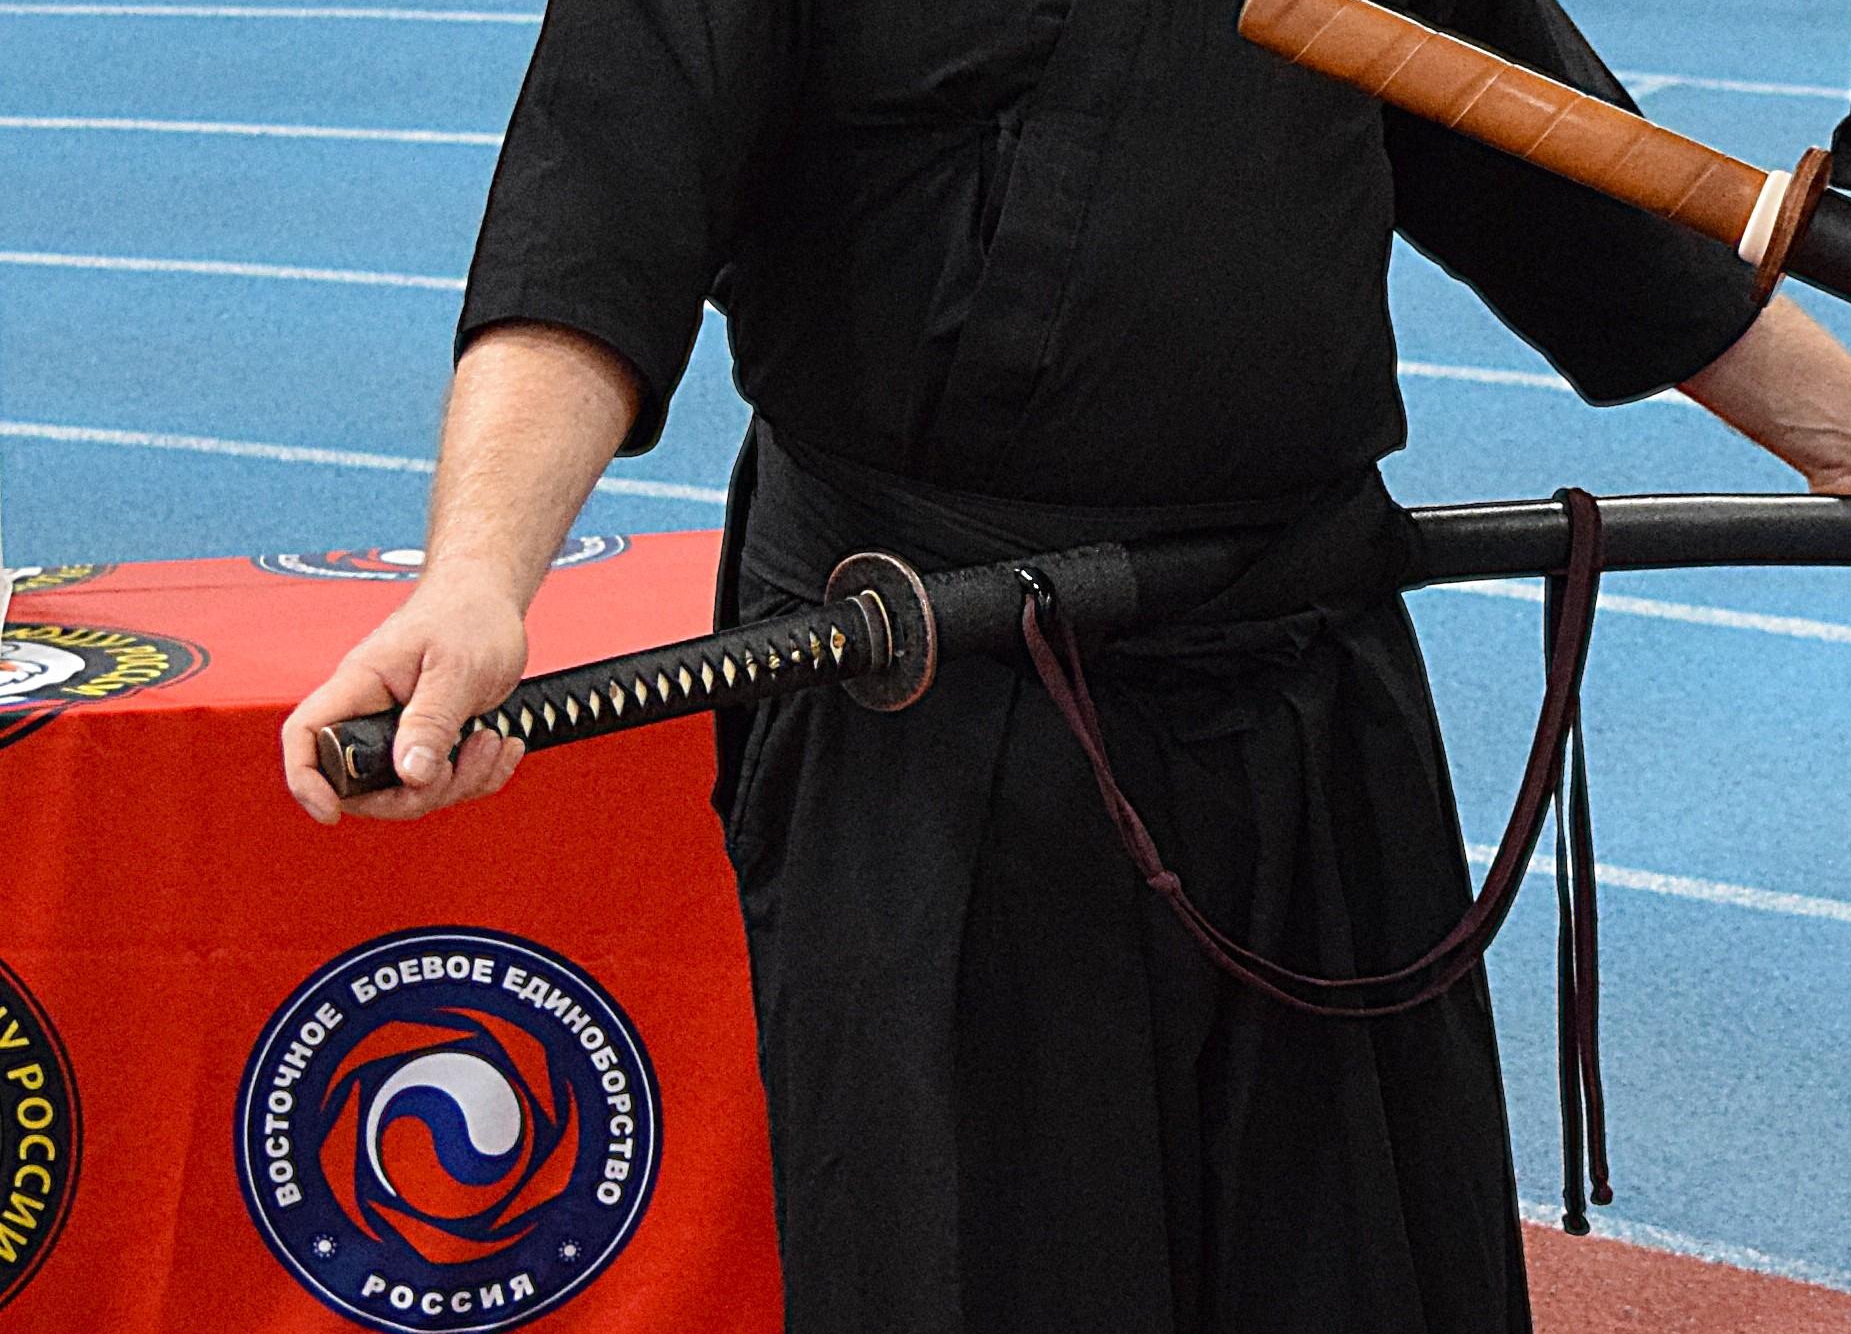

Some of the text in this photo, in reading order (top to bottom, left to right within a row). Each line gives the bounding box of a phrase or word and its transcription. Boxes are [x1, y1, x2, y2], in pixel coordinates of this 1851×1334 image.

[264, 955, 634, 1208] ВОСТОЧНОЕ БОЕВОЕ ЕДИНОБОРСТВО
[361, 1273, 537, 1316] РОССИЯ
